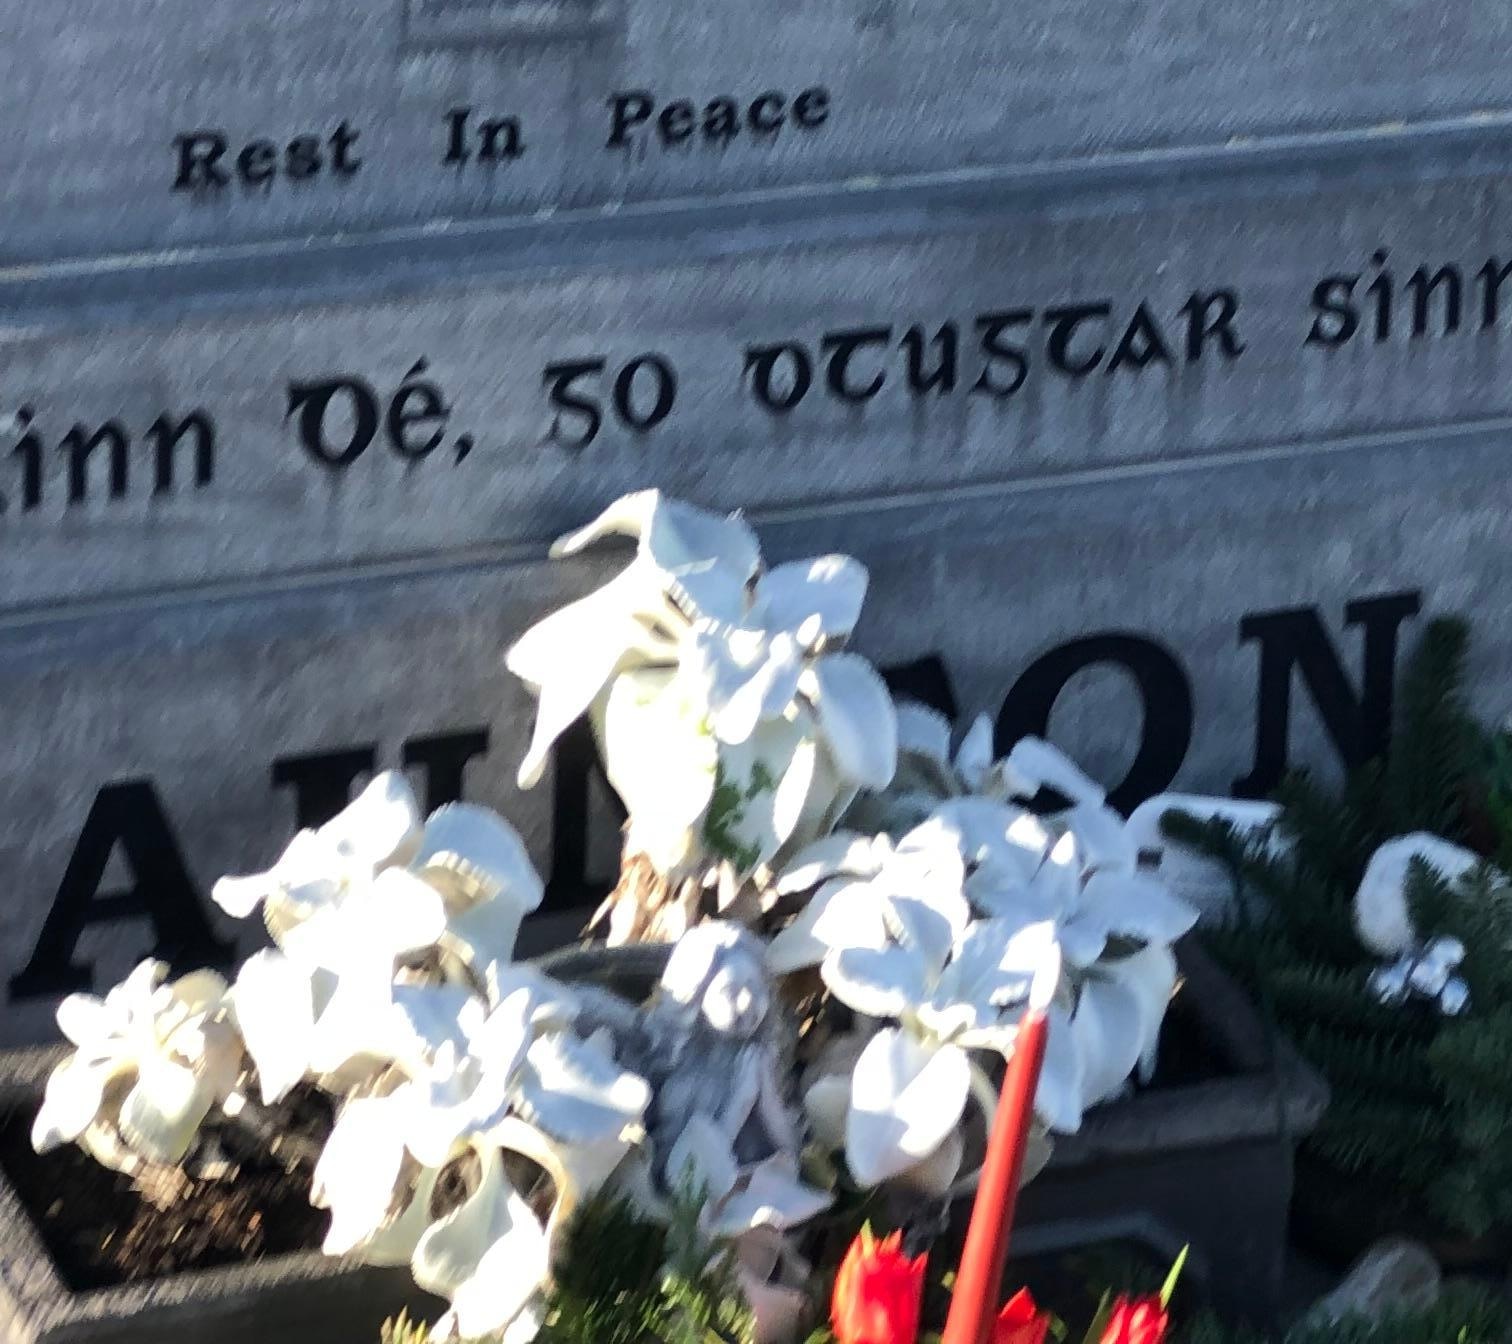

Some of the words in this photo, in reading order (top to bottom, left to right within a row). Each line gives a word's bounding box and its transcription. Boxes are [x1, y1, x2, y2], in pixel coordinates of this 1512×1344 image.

[171, 121, 362, 203] Rest
[443, 108, 525, 173] In
[605, 88, 829, 159] Peace
[0, 402, 216, 516] inn
